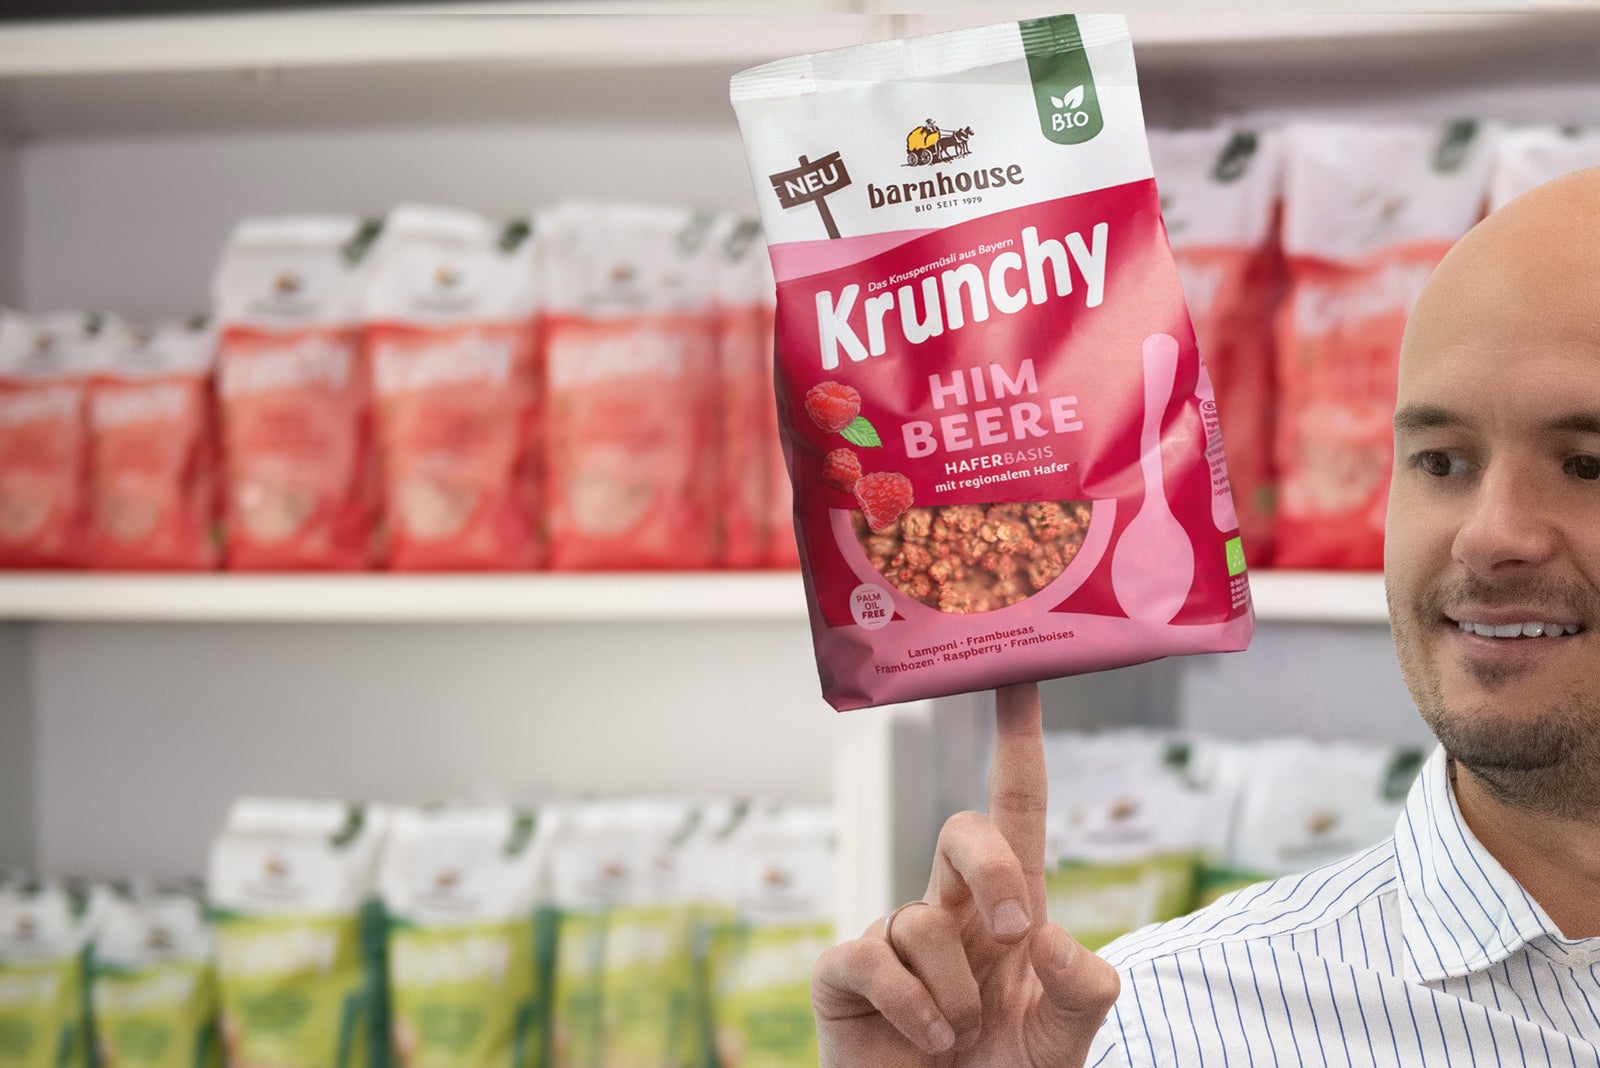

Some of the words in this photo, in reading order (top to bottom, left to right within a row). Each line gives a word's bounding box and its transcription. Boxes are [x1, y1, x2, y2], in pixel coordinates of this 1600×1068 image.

[1052, 110, 1089, 132] BIO
[784, 163, 839, 199] NEU
[867, 164, 1025, 209] barnhouse
[915, 204, 933, 213] BIO
[936, 199, 959, 209] SEIT
[962, 196, 983, 206] 1979
[867, 280, 887, 292] Das
[889, 252, 957, 285] Knuspermüsli
[958, 249, 977, 261] aus
[978, 239, 1014, 255] Bayern
[815, 222, 1109, 371] Krunchy
[928, 358, 1038, 410] HIM
[901, 395, 1083, 459] BEERE
[935, 478, 957, 493] mit
[959, 469, 1031, 490] regionalem
[1034, 462, 1070, 477] Hafer
[945, 445, 1054, 476] HAFERBASIS
[856, 593, 882, 603] PALM
[862, 609, 886, 619] FREE
[864, 601, 880, 610] OIL
[875, 658, 935, 675] Frambozen
[943, 643, 1002, 663] Raspberry
[1010, 630, 1075, 649] Framboises
[908, 639, 959, 659] Lamponi
[966, 625, 1035, 646] Frambuesas
